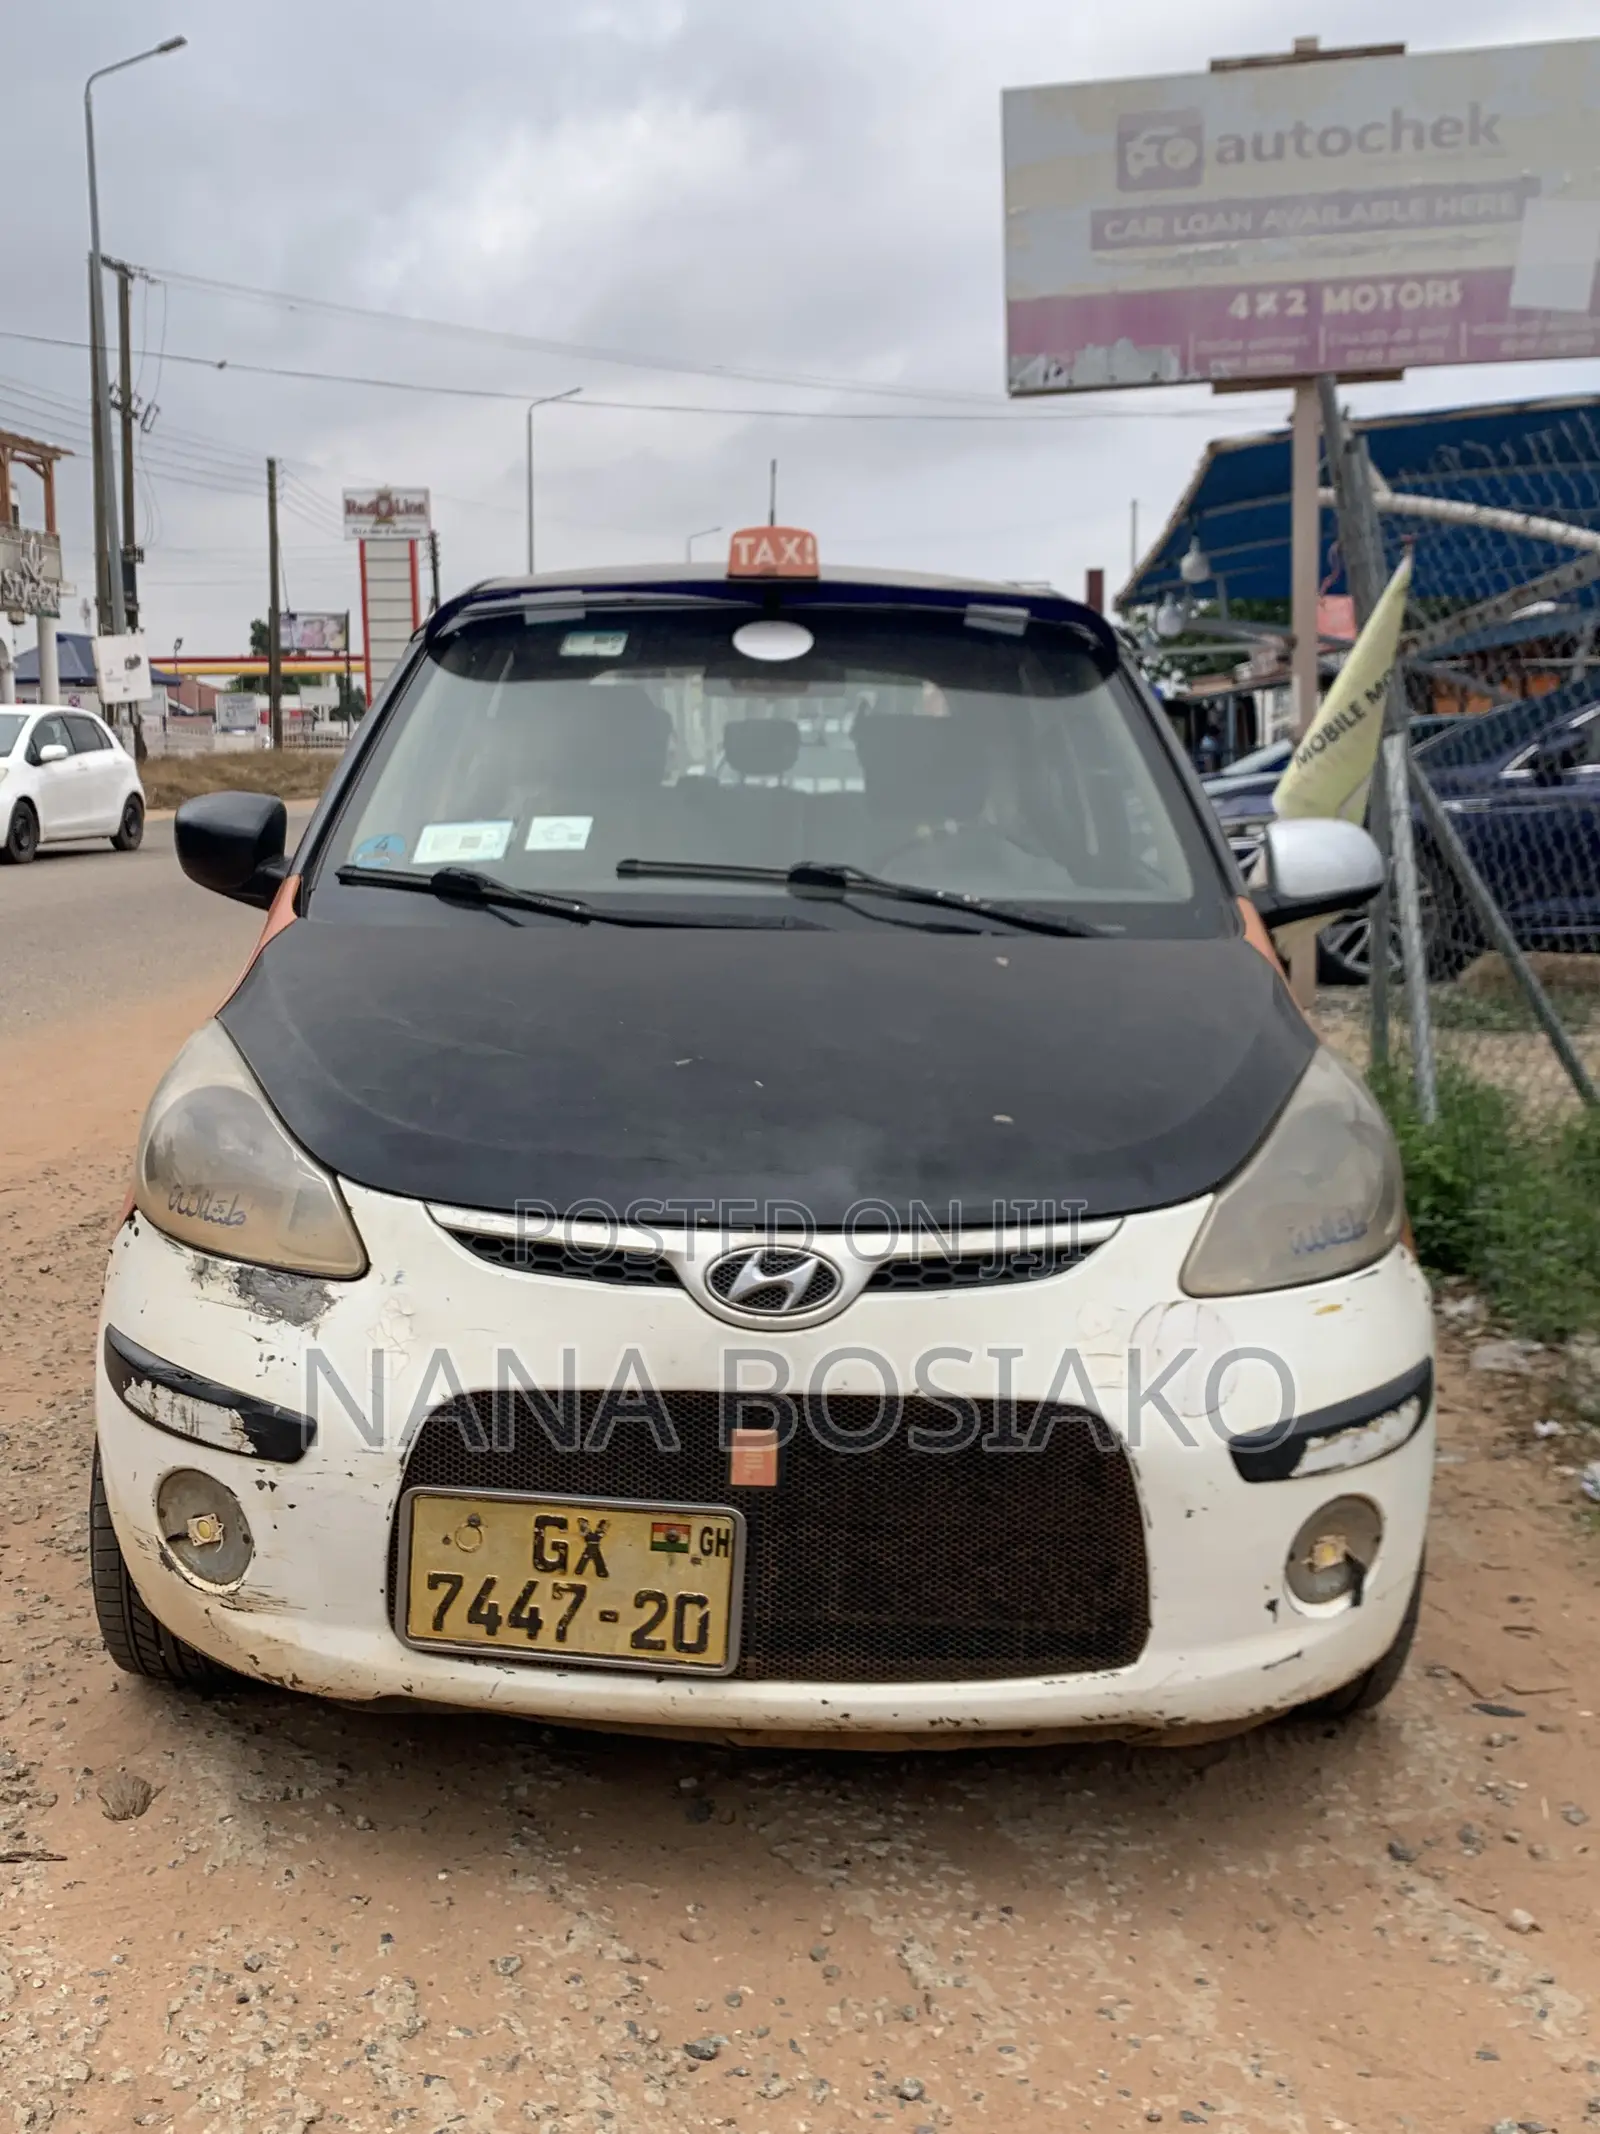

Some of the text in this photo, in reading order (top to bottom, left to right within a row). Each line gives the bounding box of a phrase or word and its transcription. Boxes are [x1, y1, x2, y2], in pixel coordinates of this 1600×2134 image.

[1216, 102, 1500, 165] autochek
[1104, 189, 1518, 241] CAR LOAN AVAILABLE HERE
[1323, 280, 1463, 315] MOTORS
[734, 537, 814, 566] TAXI
[1295, 698, 1367, 768] MOBILE
[533, 1514, 609, 1579] GX
[700, 1525, 730, 1558] GH
[427, 1571, 711, 1654] 7447-20
